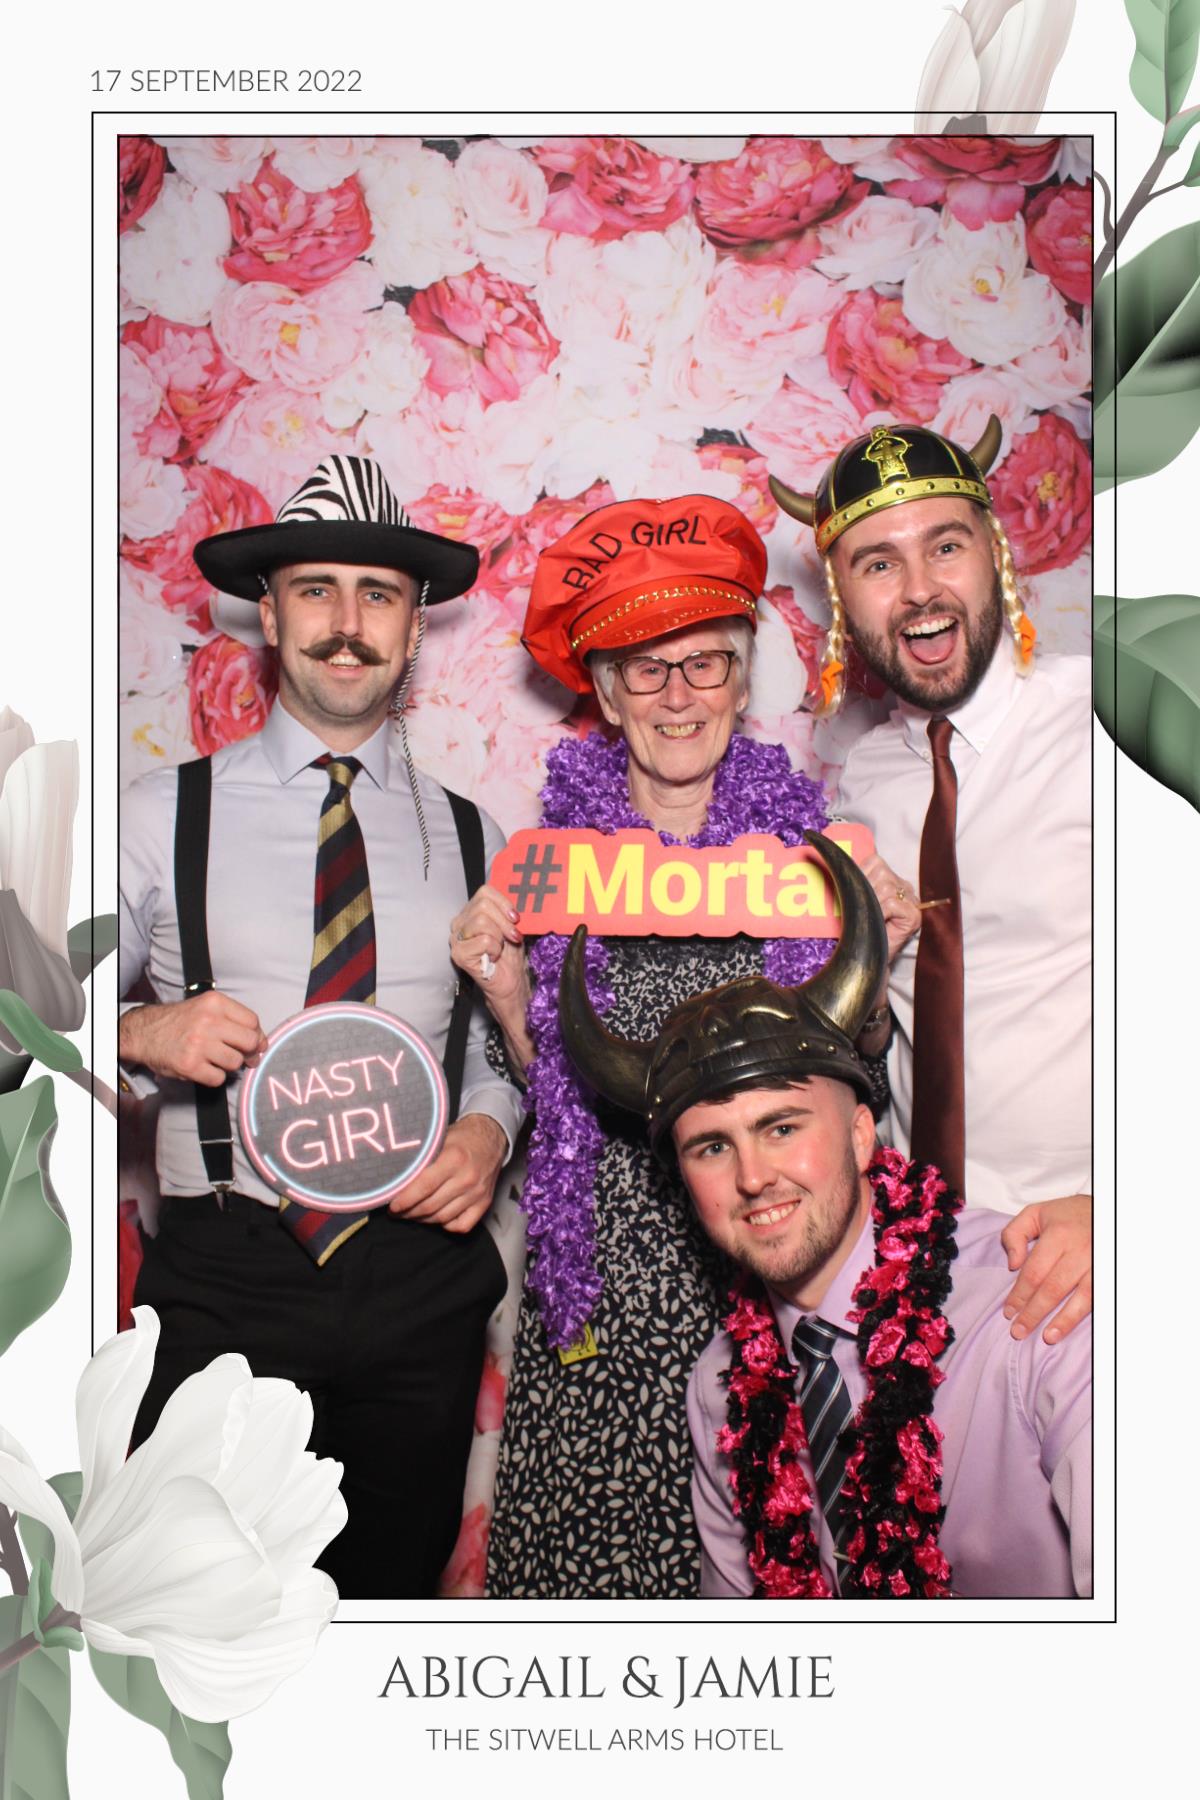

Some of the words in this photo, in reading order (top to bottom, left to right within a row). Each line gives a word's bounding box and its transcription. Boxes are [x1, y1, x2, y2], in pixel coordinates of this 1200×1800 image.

[562, 533, 622, 591] BAD
[631, 515, 707, 547] GIRL
[268, 1050, 404, 1110] NASTY
[281, 1102, 421, 1169] GIRL
